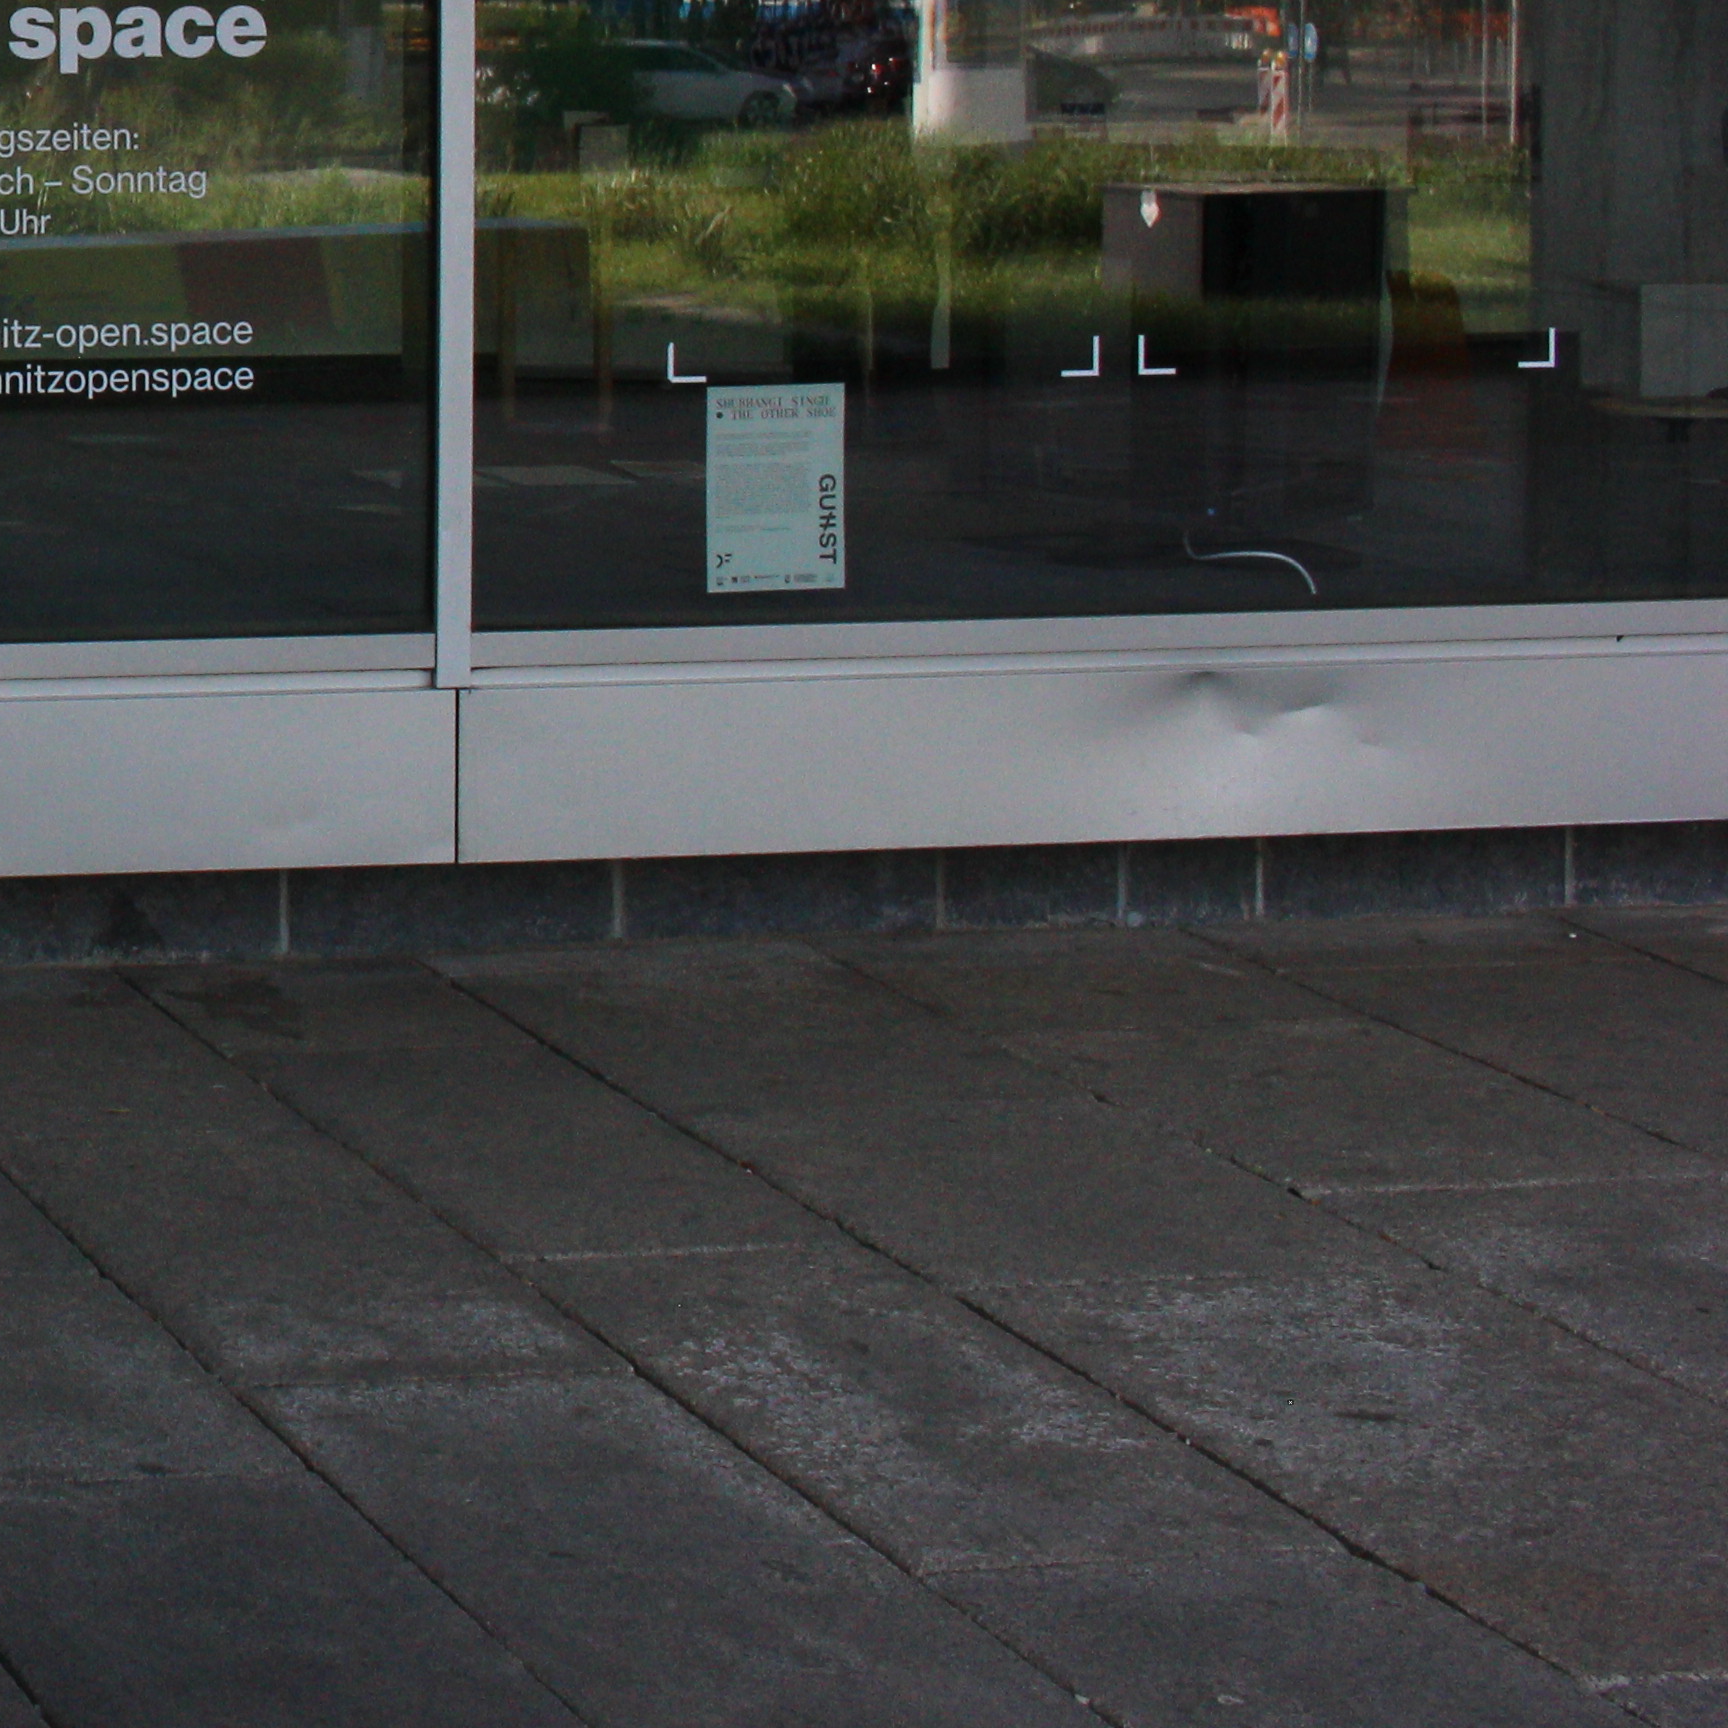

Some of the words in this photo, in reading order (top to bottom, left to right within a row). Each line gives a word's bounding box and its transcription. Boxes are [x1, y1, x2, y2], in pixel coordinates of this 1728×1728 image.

[8, 5, 267, 73] space
[72, 165, 208, 198] Sonntag
[0, 209, 51, 236] Uhr
[761, 408, 799, 419] OTHER
